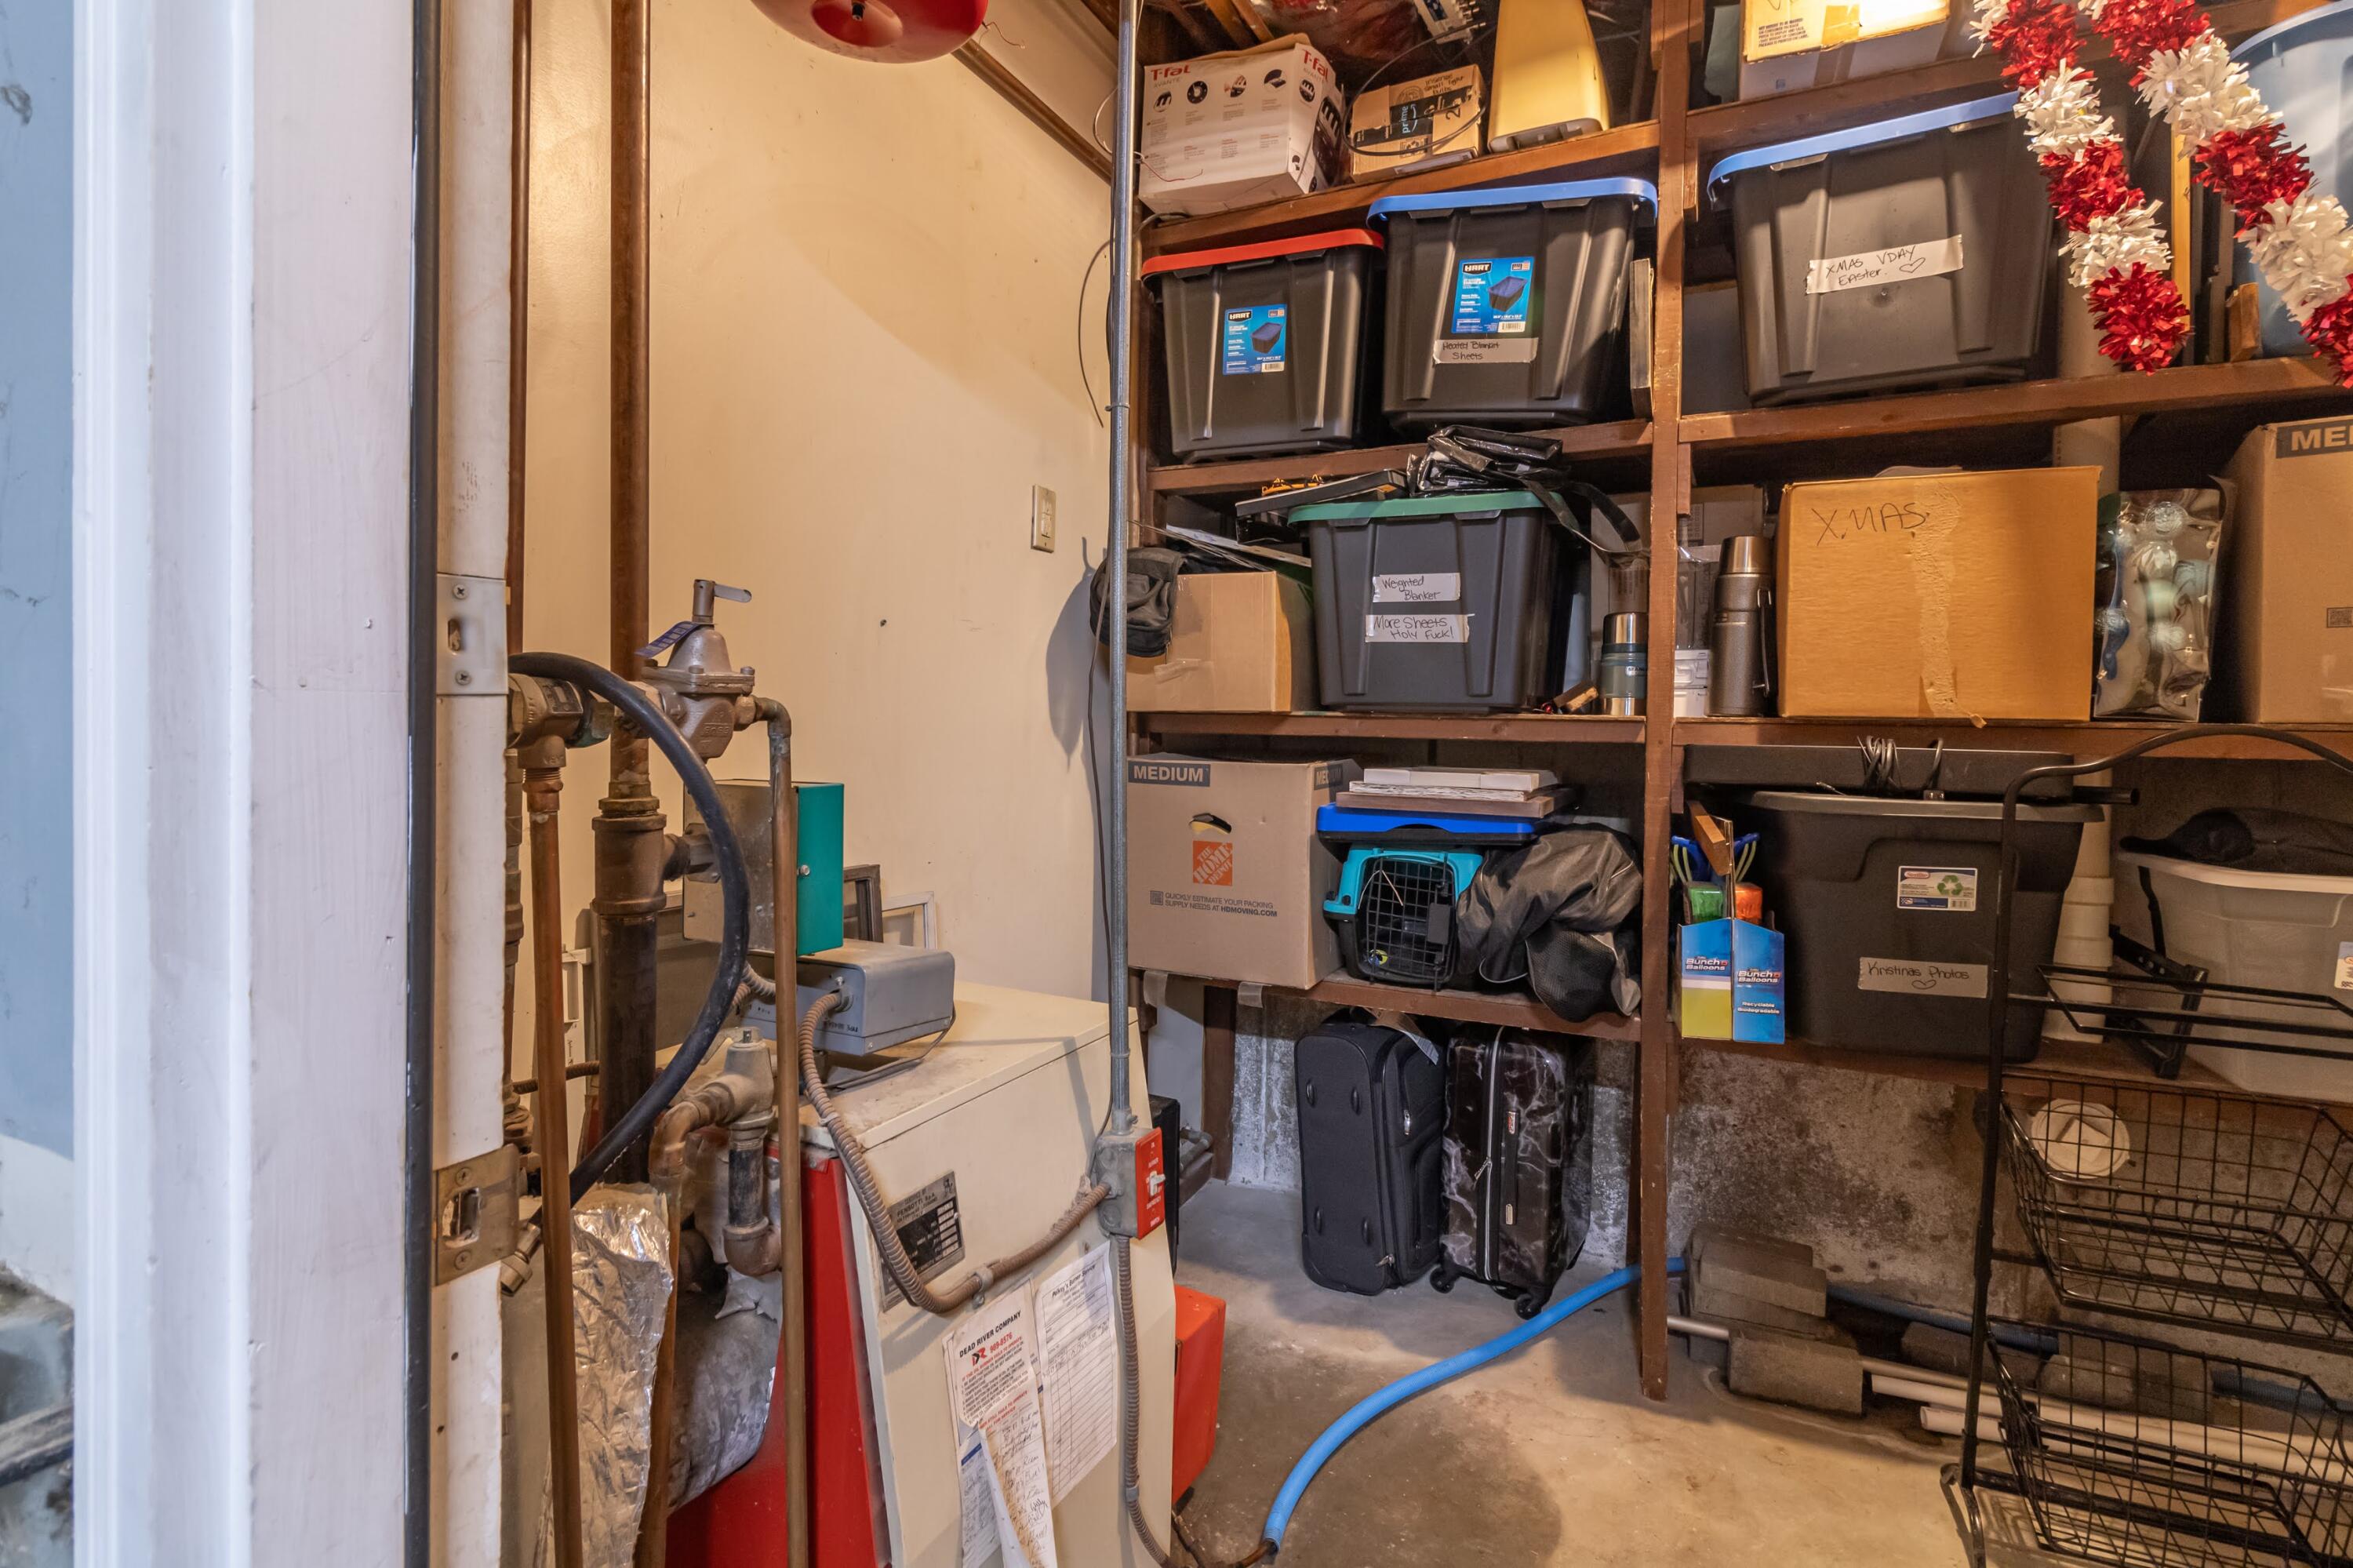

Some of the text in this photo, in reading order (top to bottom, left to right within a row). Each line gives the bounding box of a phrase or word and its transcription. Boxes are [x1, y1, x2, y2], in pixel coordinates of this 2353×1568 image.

[1302, 49, 1329, 79] T-fal
[1151, 64, 1191, 82] T-fal
[1399, 105, 1411, 134] prime
[1464, 264, 1490, 272] HART
[1826, 245, 1916, 278] XMAS VDAY
[1229, 311, 1251, 320] HART
[1374, 616, 1447, 629] More Sheets
[1391, 631, 1417, 640] Holy
[1133, 765, 1203, 783] MEDIUM
[1193, 843, 1231, 882] HOME
[1165, 892, 1273, 909] QUICKLY ESTIMATE YOUR PACKING
[1165, 900, 1188, 908] SUPPLY
[1221, 906, 1278, 917] HDMOVING.COM
[1929, 966, 1970, 979] Photos
[959, 1310, 1021, 1358] DEAD RIVER COMPANY
